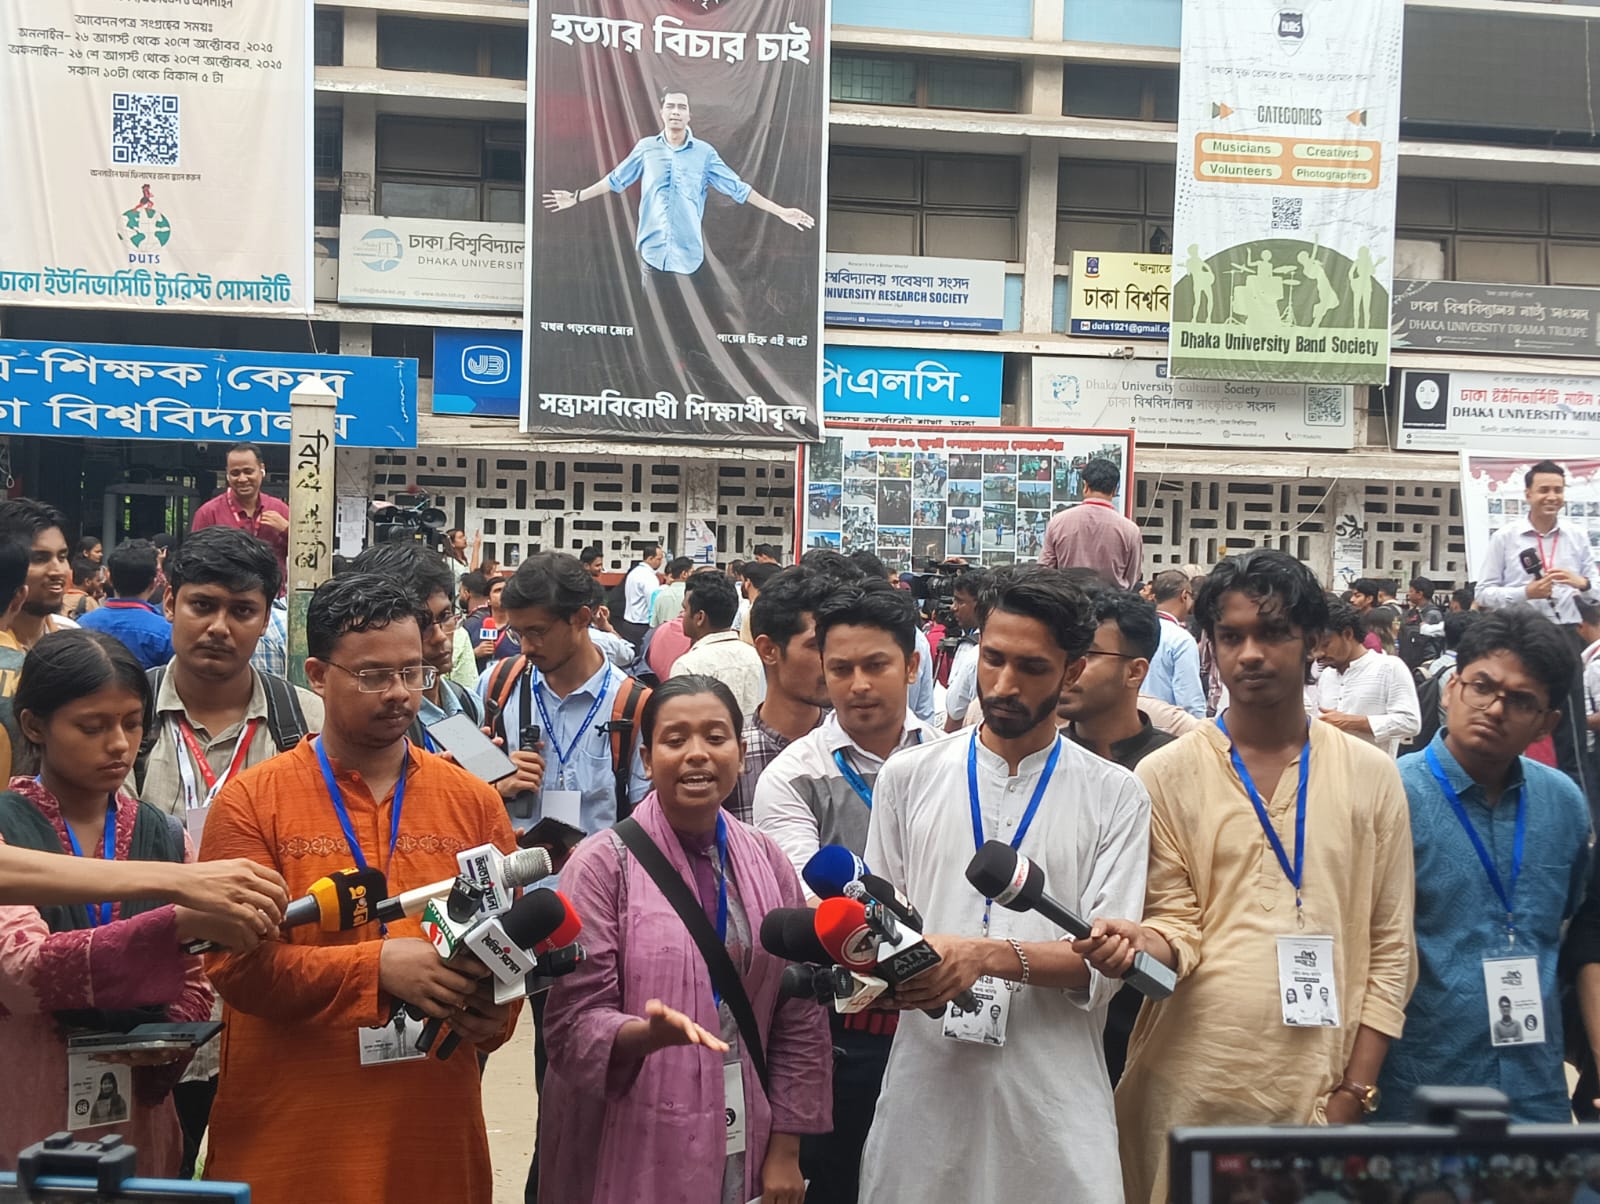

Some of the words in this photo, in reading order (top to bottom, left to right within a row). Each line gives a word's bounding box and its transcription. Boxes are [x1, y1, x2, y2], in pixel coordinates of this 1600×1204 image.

[75, 14, 136, 28] আবেদনপত্র
[75, 32, 89, 42] ২৬
[133, 35, 160, 47] থেকে
[551, 13, 644, 53] হত্যার
[653, 14, 747, 64] বিচার
[756, 21, 812, 65] চাই
[69, 48, 83, 59] ২৬
[143, 53, 170, 64] থেকে
[256, 59, 282, 70] ২০২৫
[67, 65, 100, 77] সকাল
[103, 66, 129, 79] ১০টা
[132, 69, 160, 80] থেকে
[163, 67, 198, 82] বিকাল
[202, 73, 208, 83] ৫
[212, 71, 224, 84] টা
[1257, 105, 1322, 126] CATEGORIES
[1212, 141, 1271, 154] Musicians
[1306, 147, 1359, 159] Creatives
[1209, 164, 1273, 177] Volunteers
[1296, 168, 1367, 182] Photographers
[408, 234, 444, 250] ঢাকা
[449, 231, 525, 256] বিশ্ববিদ্যাল
[128, 253, 160, 264] DUTS
[418, 256, 458, 267] DHAKA
[462, 259, 524, 270] UNIVERSIT
[0, 270, 41, 293] ঢাকা
[44, 267, 151, 297] ইউনিভার্সিটি
[216, 273, 292, 303] সোসাইটি
[891, 275, 934, 289] গবেষণা
[937, 277, 970, 290] সংসদ
[878, 290, 927, 303] RESEARCH
[929, 291, 969, 304] SOCIETY
[1083, 287, 1120, 310] ঢাকা
[1125, 283, 1171, 312] বিশ্ববি
[1410, 300, 1439, 313] ঢাকা
[1551, 306, 1590, 321] সংসদ
[540, 321, 565, 333] যখন
[1409, 319, 1445, 331] DHAKA
[1447, 321, 1505, 334] UNIVERSITY
[1507, 324, 1546, 336] DRAMA
[1548, 326, 1589, 338] TROUPE
[769, 333, 785, 348] এই
[1180, 330, 1220, 350] Dhaka
[1225, 332, 1290, 355] University
[1296, 336, 1326, 353] Band
[1331, 336, 1379, 357] Society
[1086, 380, 1117, 391] Dhaka
[1122, 381, 1174, 394] University
[1179, 383, 1221, 394] Cultural
[1224, 384, 1261, 397] Society
[1460, 389, 1488, 402] ঢাকা
[538, 388, 679, 420] সন্ত্রাসবিরোধী
[685, 393, 808, 432] শিক্ষার্থীবৃন্দ
[1246, 400, 1276, 413] সংসদ
[1452, 406, 1494, 418] DHAKA
[1499, 408, 1568, 421] UNIVERSITY
[427, 901, 458, 945] CHANNEL
[893, 944, 932, 968] ATN
[897, 954, 937, 976] BANGLA
